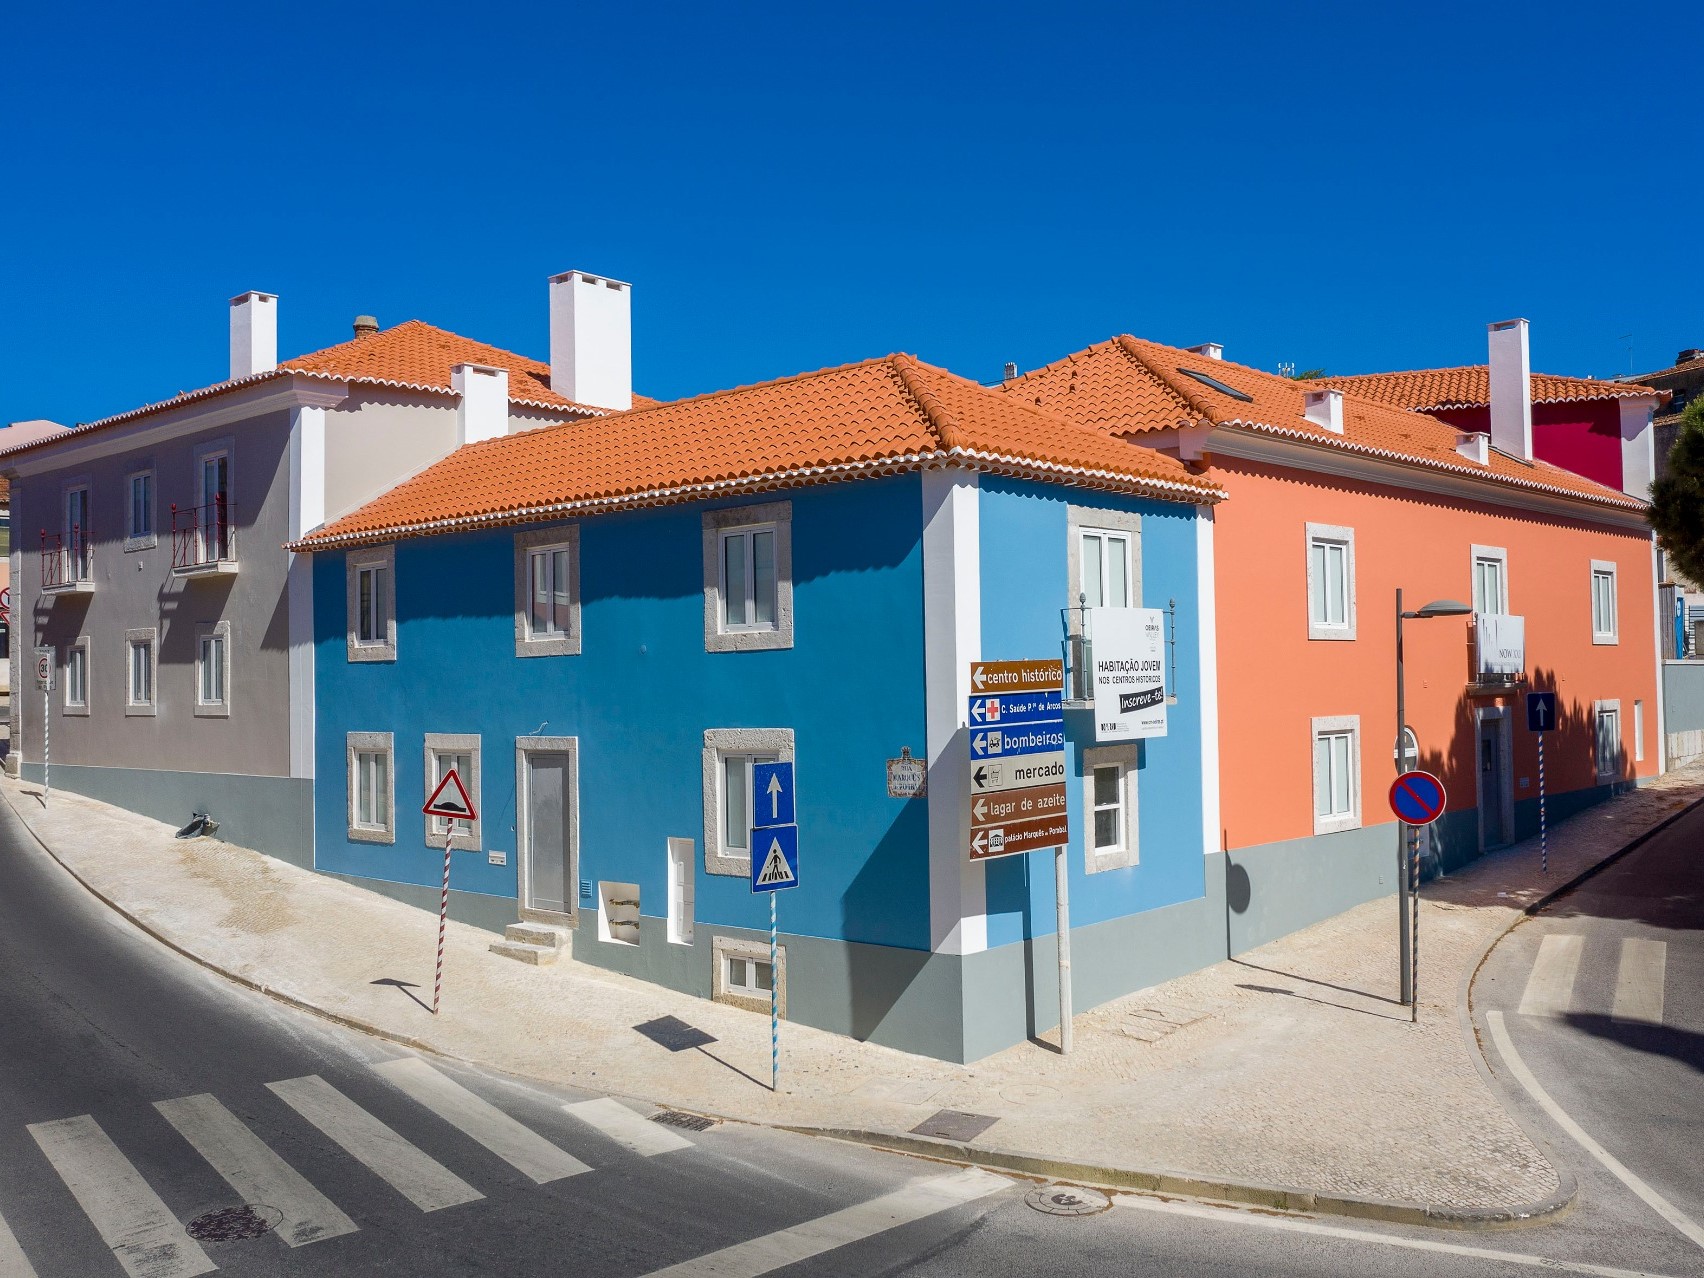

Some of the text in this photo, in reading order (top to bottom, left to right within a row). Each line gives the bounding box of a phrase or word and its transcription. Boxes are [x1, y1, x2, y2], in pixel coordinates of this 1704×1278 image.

[1098, 658, 1161, 675] HABITAÇÃO JOVEM
[988, 667, 1062, 684] centro histórico
[1098, 676, 1110, 684] NOS
[1112, 675, 1136, 684] CENTROS
[1121, 688, 1163, 709] Inscreve-te!
[1001, 704, 1008, 714] C.
[1010, 703, 1027, 713] Saúde
[1038, 702, 1044, 711] de
[1046, 702, 1062, 710] Arcos
[1004, 731, 1063, 749] bombeiros
[1015, 762, 1064, 780] mercado
[990, 794, 1065, 817] lagar de azeite
[1004, 832, 1023, 844] palácio
[1024, 828, 1044, 840] Marquês
